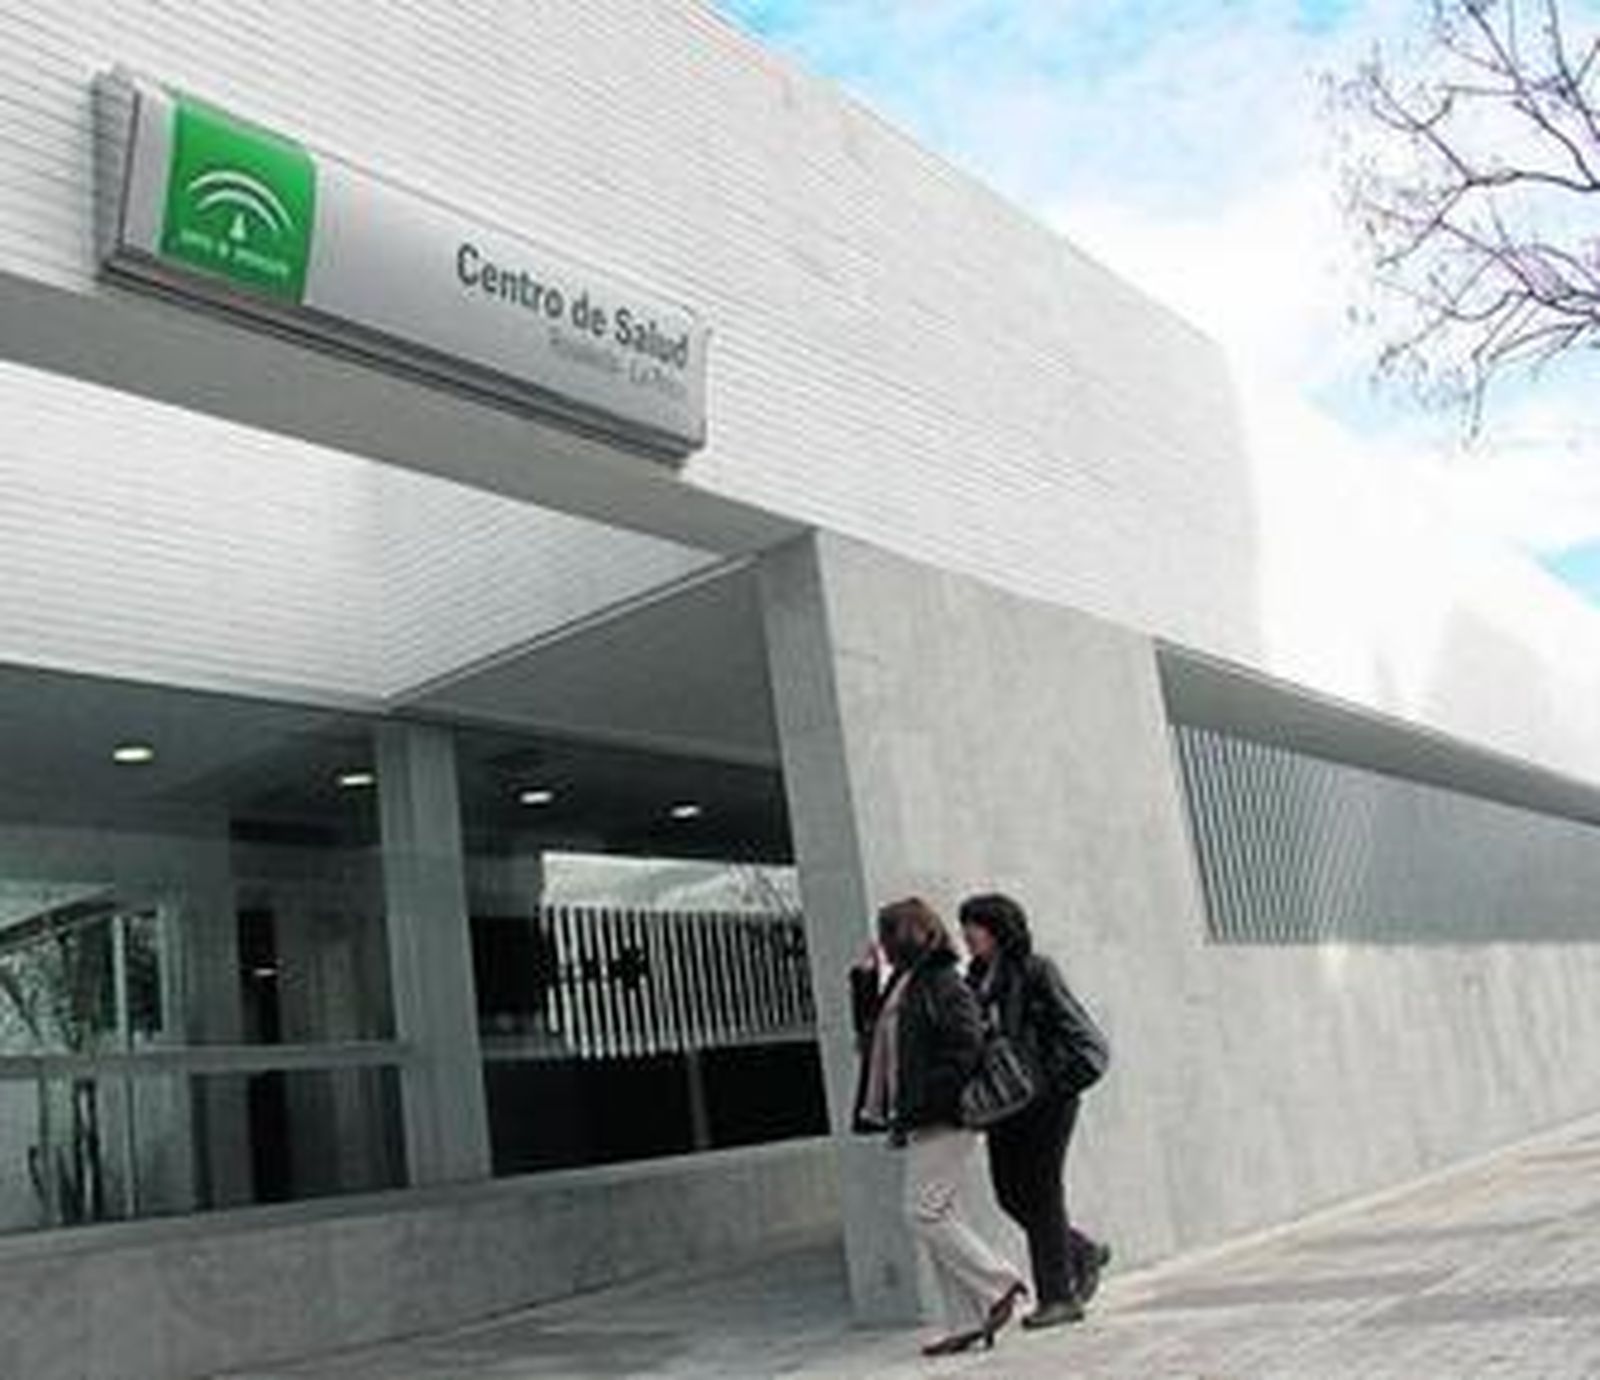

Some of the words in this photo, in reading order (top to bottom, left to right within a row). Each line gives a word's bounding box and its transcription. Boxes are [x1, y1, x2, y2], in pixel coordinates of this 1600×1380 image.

[457, 243, 564, 318] Centro
[572, 289, 607, 337] de
[615, 307, 689, 370] Salud
